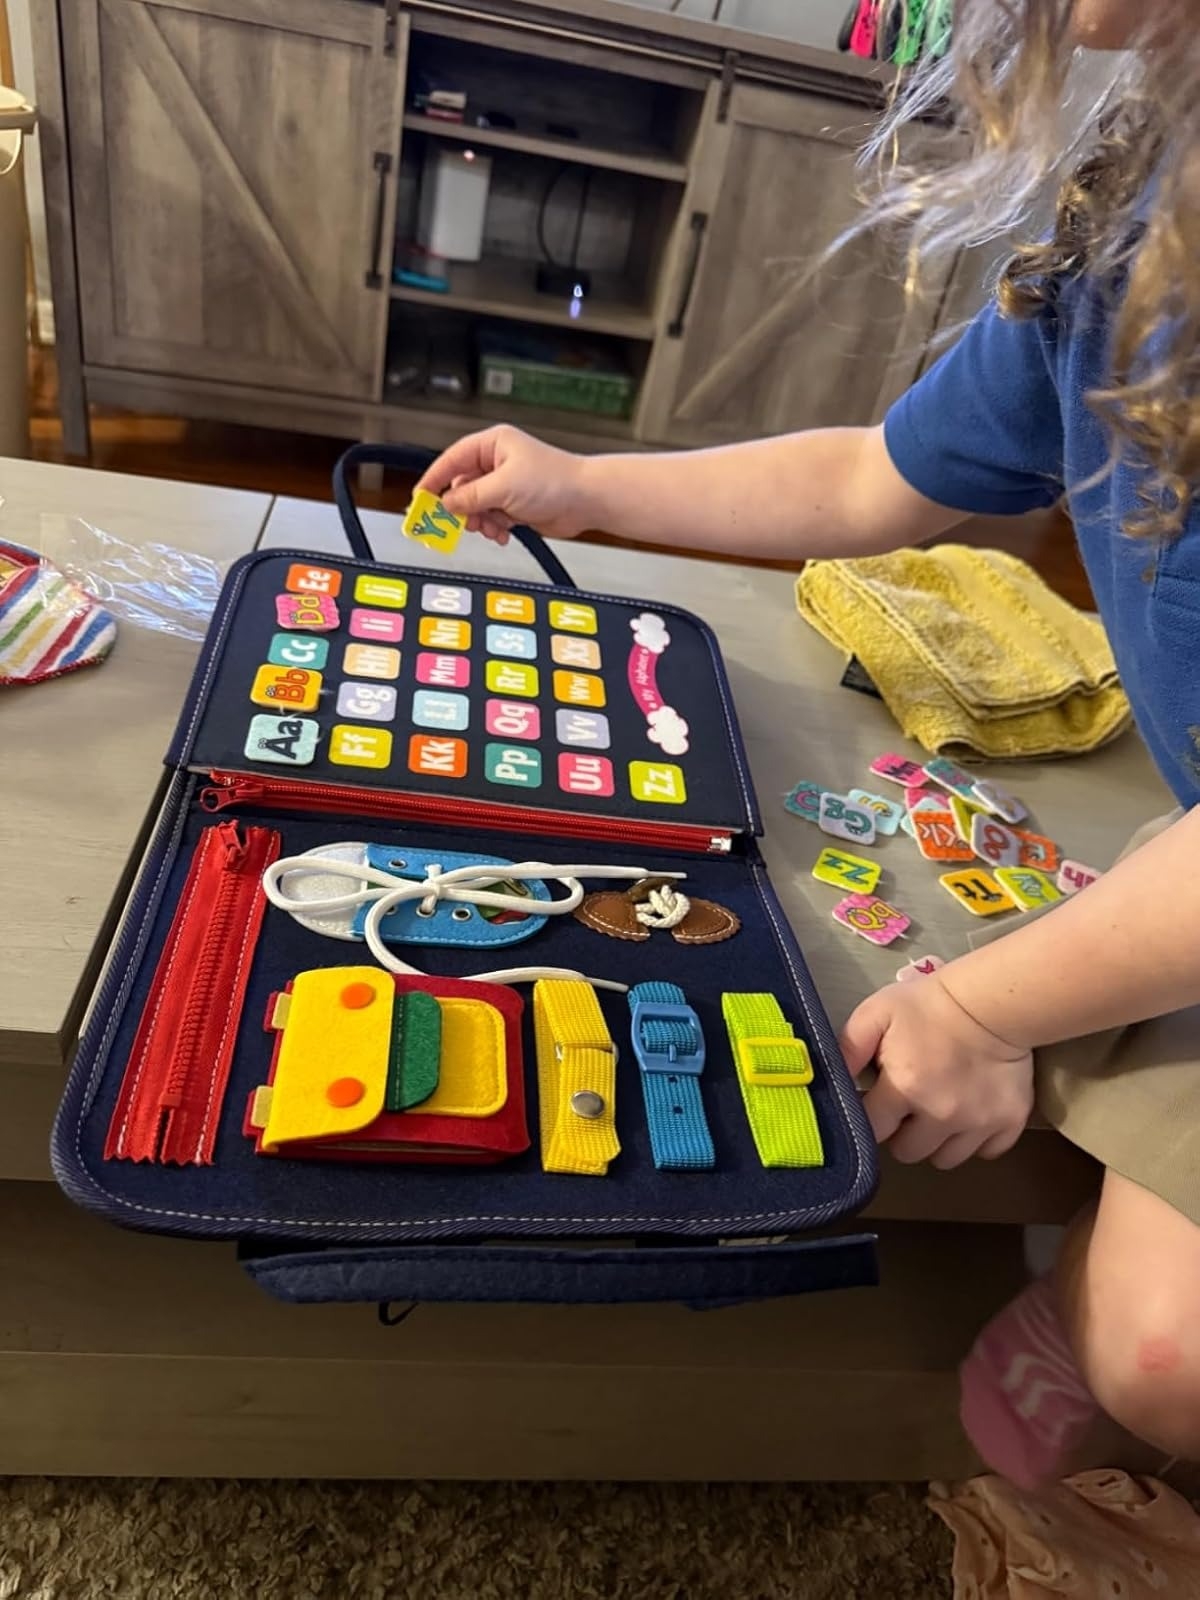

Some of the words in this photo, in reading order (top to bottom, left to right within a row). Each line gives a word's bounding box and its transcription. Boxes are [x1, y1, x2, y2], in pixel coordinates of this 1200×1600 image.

[413, 501, 460, 539] Yy
[297, 570, 332, 592] Ee
[291, 595, 325, 626] Dd
[431, 587, 461, 611] Oo
[495, 598, 525, 616] Tt
[360, 617, 394, 632] Ii
[557, 606, 594, 627] Yy
[429, 618, 461, 647] Nn
[494, 632, 525, 652] Ss
[280, 639, 319, 664] Cc
[358, 647, 392, 676] Hh
[560, 641, 591, 665] Xx
[429, 654, 457, 686] Mm
[495, 665, 527, 691] Rr
[271, 669, 310, 703] Bb
[567, 675, 590, 701] Ww
[346, 687, 392, 716] Gg
[423, 699, 457, 722] Ll
[493, 703, 537, 735] Qq
[565, 714, 599, 741] Vv
[262, 720, 304, 760] Aa
[340, 731, 378, 759] Ff
[419, 739, 456, 772] Kk
[494, 749, 539, 782] Pp
[568, 757, 603, 791] Uu
[642, 767, 677, 798] Zz
[823, 797, 873, 835] Gg
[983, 823, 1010, 860] Oo
[821, 853, 875, 885] Zz
[953, 878, 1003, 902] Tt
[847, 901, 903, 930] Qq
